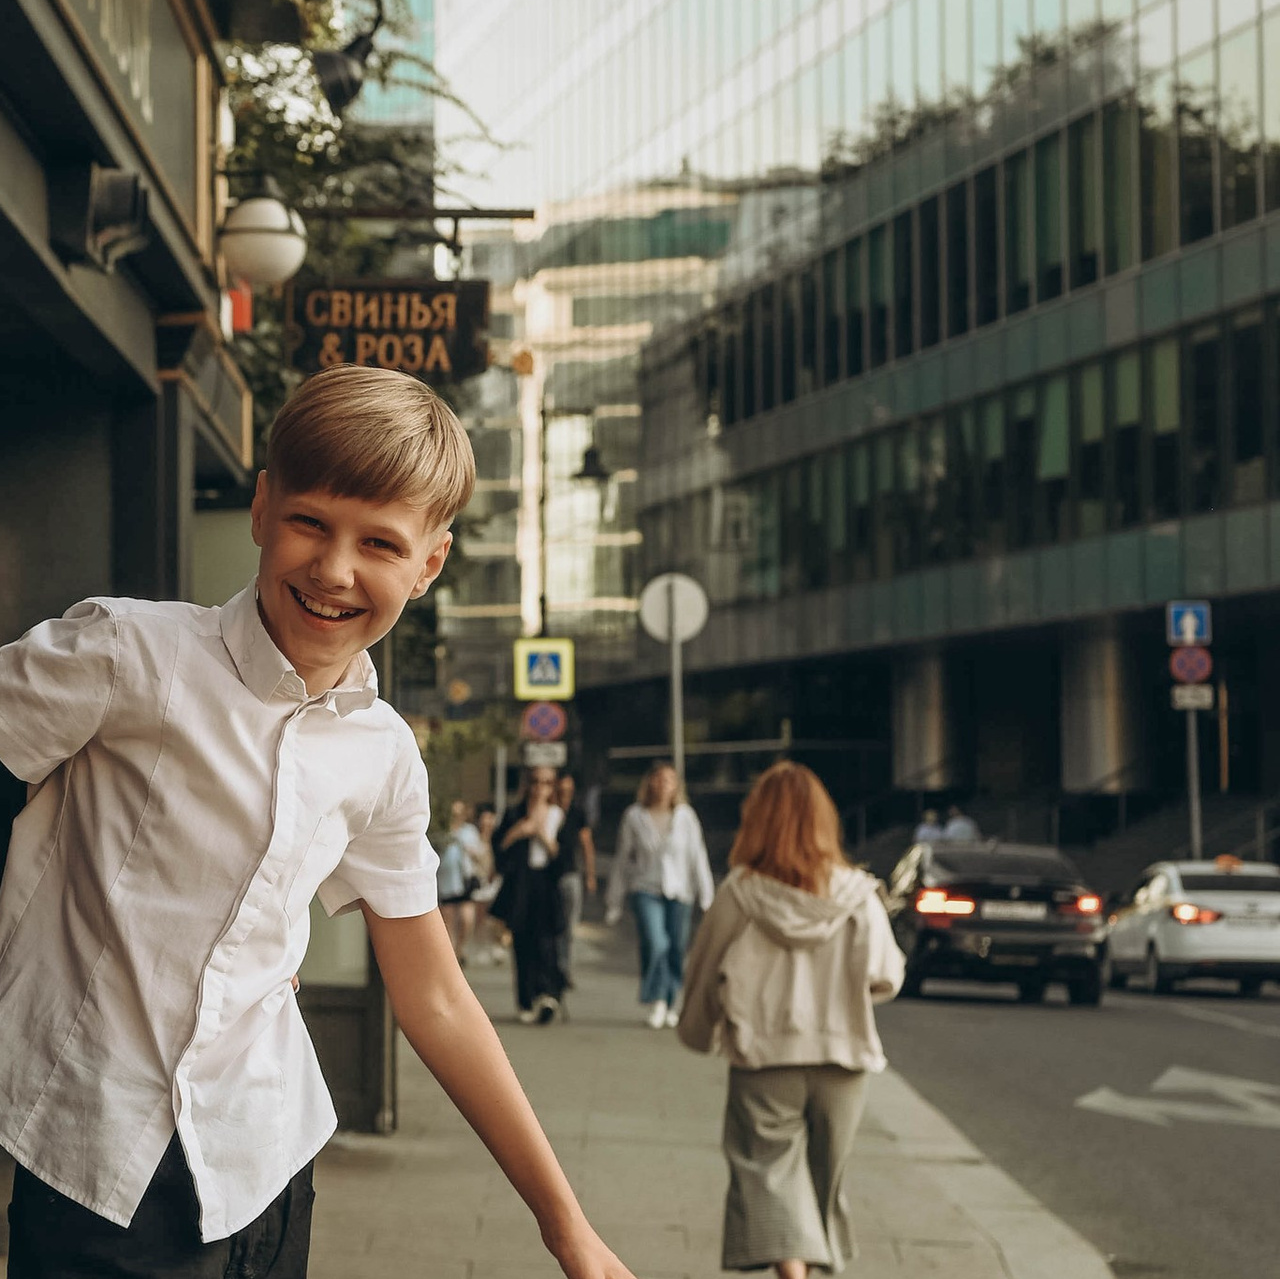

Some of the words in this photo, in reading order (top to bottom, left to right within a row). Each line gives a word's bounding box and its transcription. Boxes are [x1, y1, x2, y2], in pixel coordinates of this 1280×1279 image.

[306, 290, 457, 331] СВИНЬЯ
[320, 332, 345, 368] &
[355, 333, 452, 373] РОЗА
